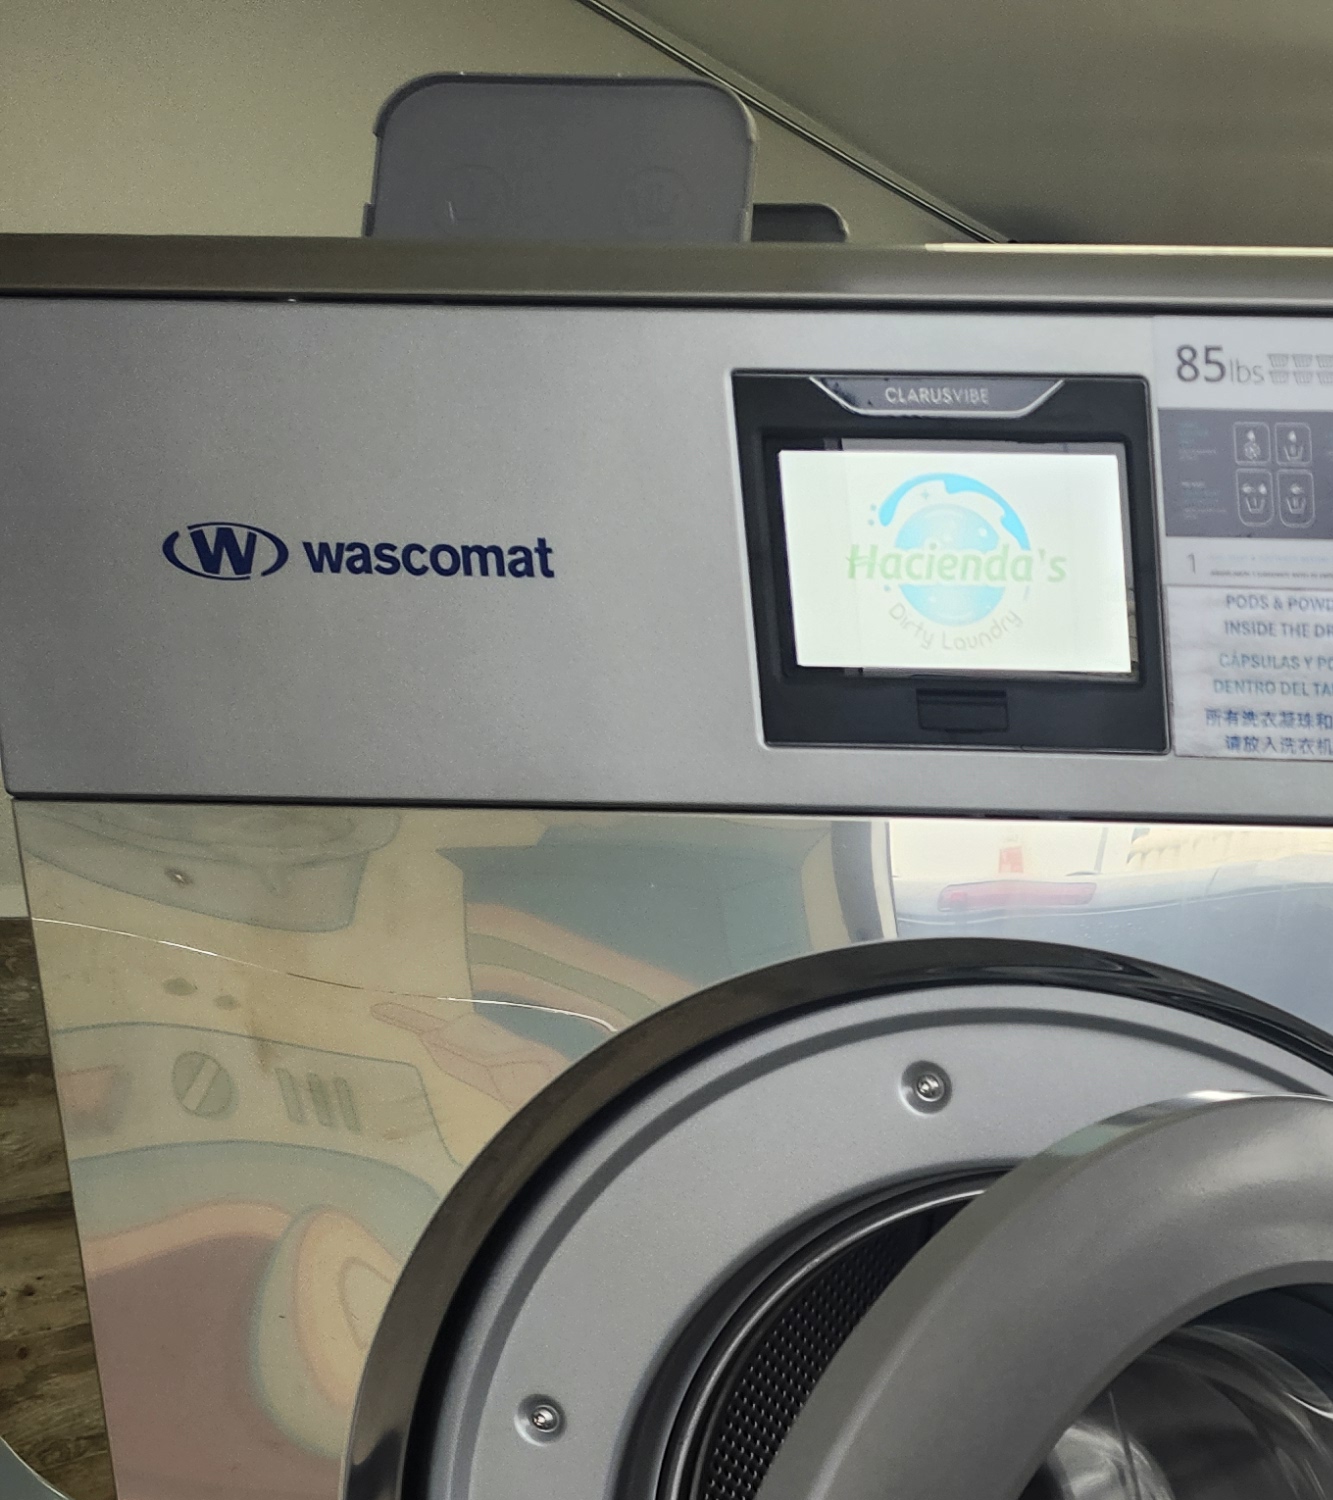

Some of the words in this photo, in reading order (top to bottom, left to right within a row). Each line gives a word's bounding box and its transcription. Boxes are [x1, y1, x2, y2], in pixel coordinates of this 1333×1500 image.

[884, 386, 989, 405] CLARUSVIBE
[302, 538, 555, 578] wascomat
[846, 543, 1069, 583] Hacienda's
[1225, 594, 1269, 610] PODS
[1274, 596, 1283, 611] &
[888, 602, 934, 650] Dirty
[942, 608, 1023, 651] Laundry
[1224, 620, 1276, 637] INSIDE
[1281, 622, 1309, 638] THE
[1303, 658, 1314, 671] Y
[1213, 678, 1277, 695] DENTRO
[1280, 681, 1310, 698] DEL
